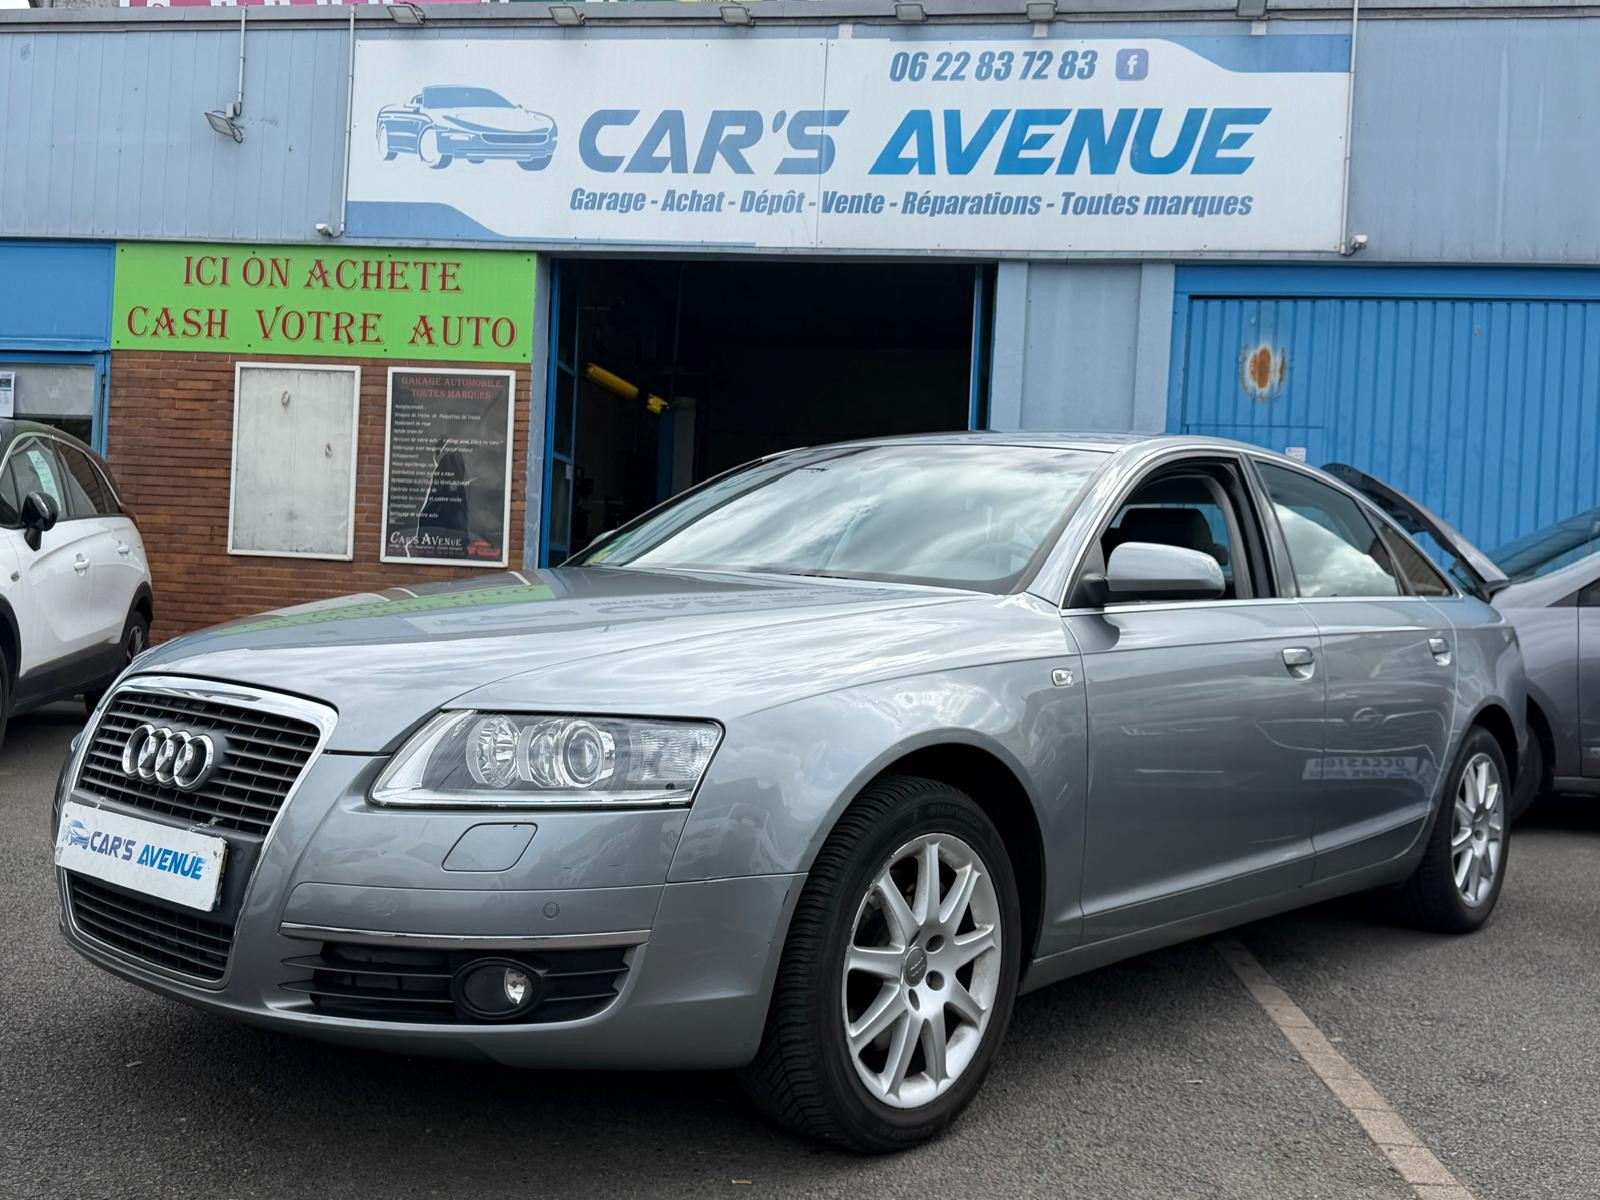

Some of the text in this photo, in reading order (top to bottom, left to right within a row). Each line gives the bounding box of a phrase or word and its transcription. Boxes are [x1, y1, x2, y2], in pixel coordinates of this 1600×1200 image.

[889, 51, 929, 82] 06
[932, 50, 971, 81] 22
[974, 50, 1015, 81] 83
[1018, 50, 1055, 81] 72
[1057, 50, 1098, 80] 83
[578, 107, 1273, 176] CAR'S AVENUE
[569, 188, 646, 214] Garage
[661, 189, 725, 213] Achat
[739, 189, 805, 215] Dépôt
[820, 190, 885, 214] Vente
[901, 190, 1042, 218] Réparations
[1060, 191, 1141, 216] Toutes
[1144, 193, 1253, 219] marques
[183, 255, 463, 293] ICI ON ACHETE
[127, 304, 517, 349] CASH VOTRE AUTO
[411, 388, 491, 400] TOUTES MARQUES
[443, 378, 502, 388] AUTOMOBILE
[421, 533, 462, 547] AVENUE
[90, 831, 207, 880] CAR'S AVENUE
